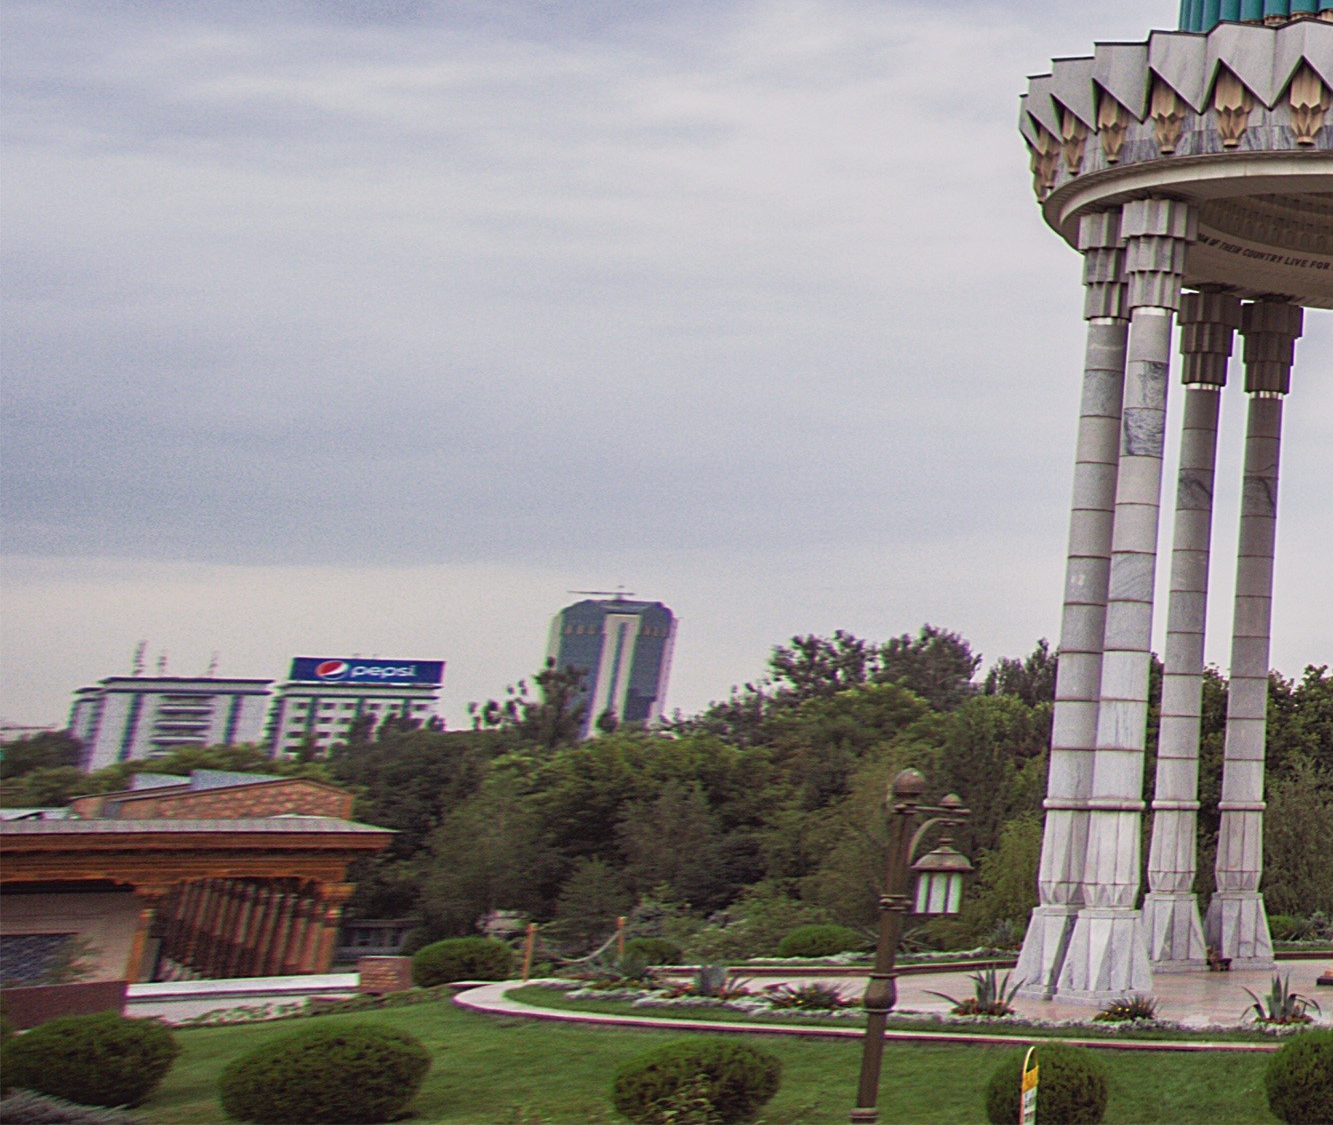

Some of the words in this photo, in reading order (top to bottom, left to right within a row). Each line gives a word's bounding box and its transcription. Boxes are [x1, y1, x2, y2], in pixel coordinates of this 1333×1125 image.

[1219, 242, 1243, 254] THEIR
[1242, 248, 1284, 263] COUNTRY
[1284, 256, 1309, 268] LIVE
[1309, 260, 1331, 270] FOR
[350, 665, 417, 680] pepsi
